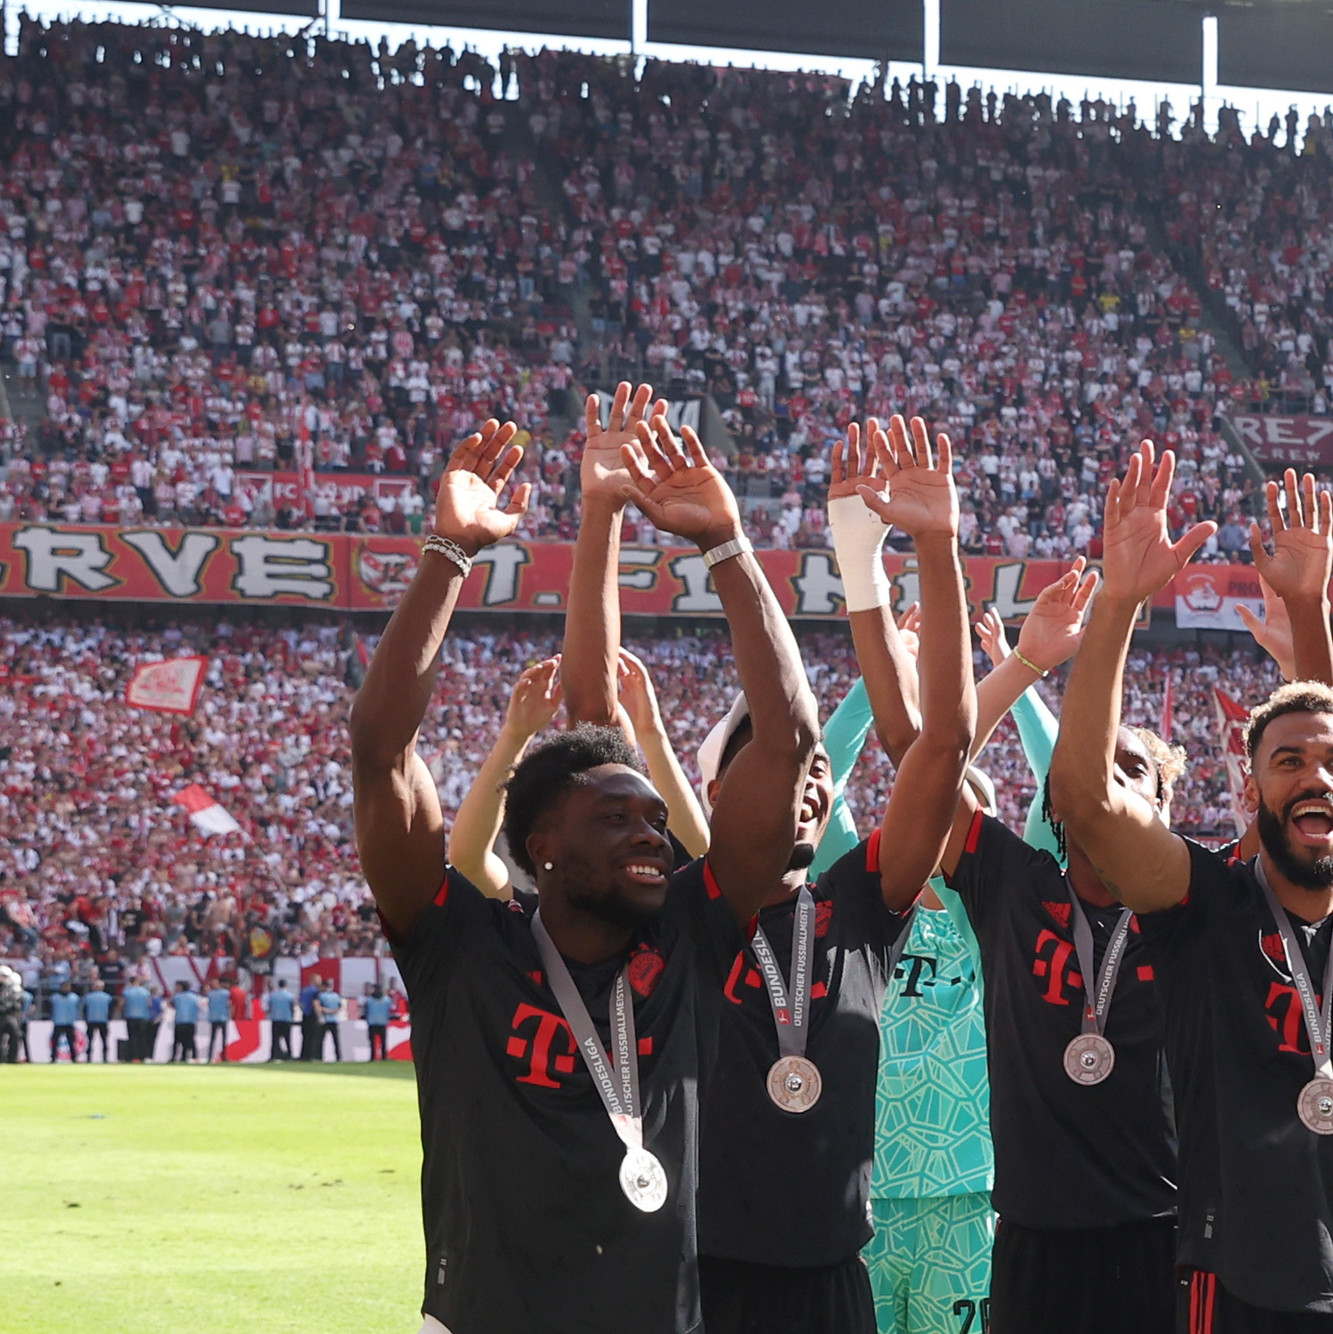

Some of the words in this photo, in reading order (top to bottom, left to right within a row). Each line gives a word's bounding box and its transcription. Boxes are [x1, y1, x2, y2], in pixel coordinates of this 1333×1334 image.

[1252, 446, 1320, 460] CREW
[0, 526, 334, 599] RVE
[616, 975, 631, 1066] FUSSBALLMEISTER
[1296, 972, 1322, 1043] BUNDESLIGA
[584, 1037, 623, 1115] BUNDESLIGA
